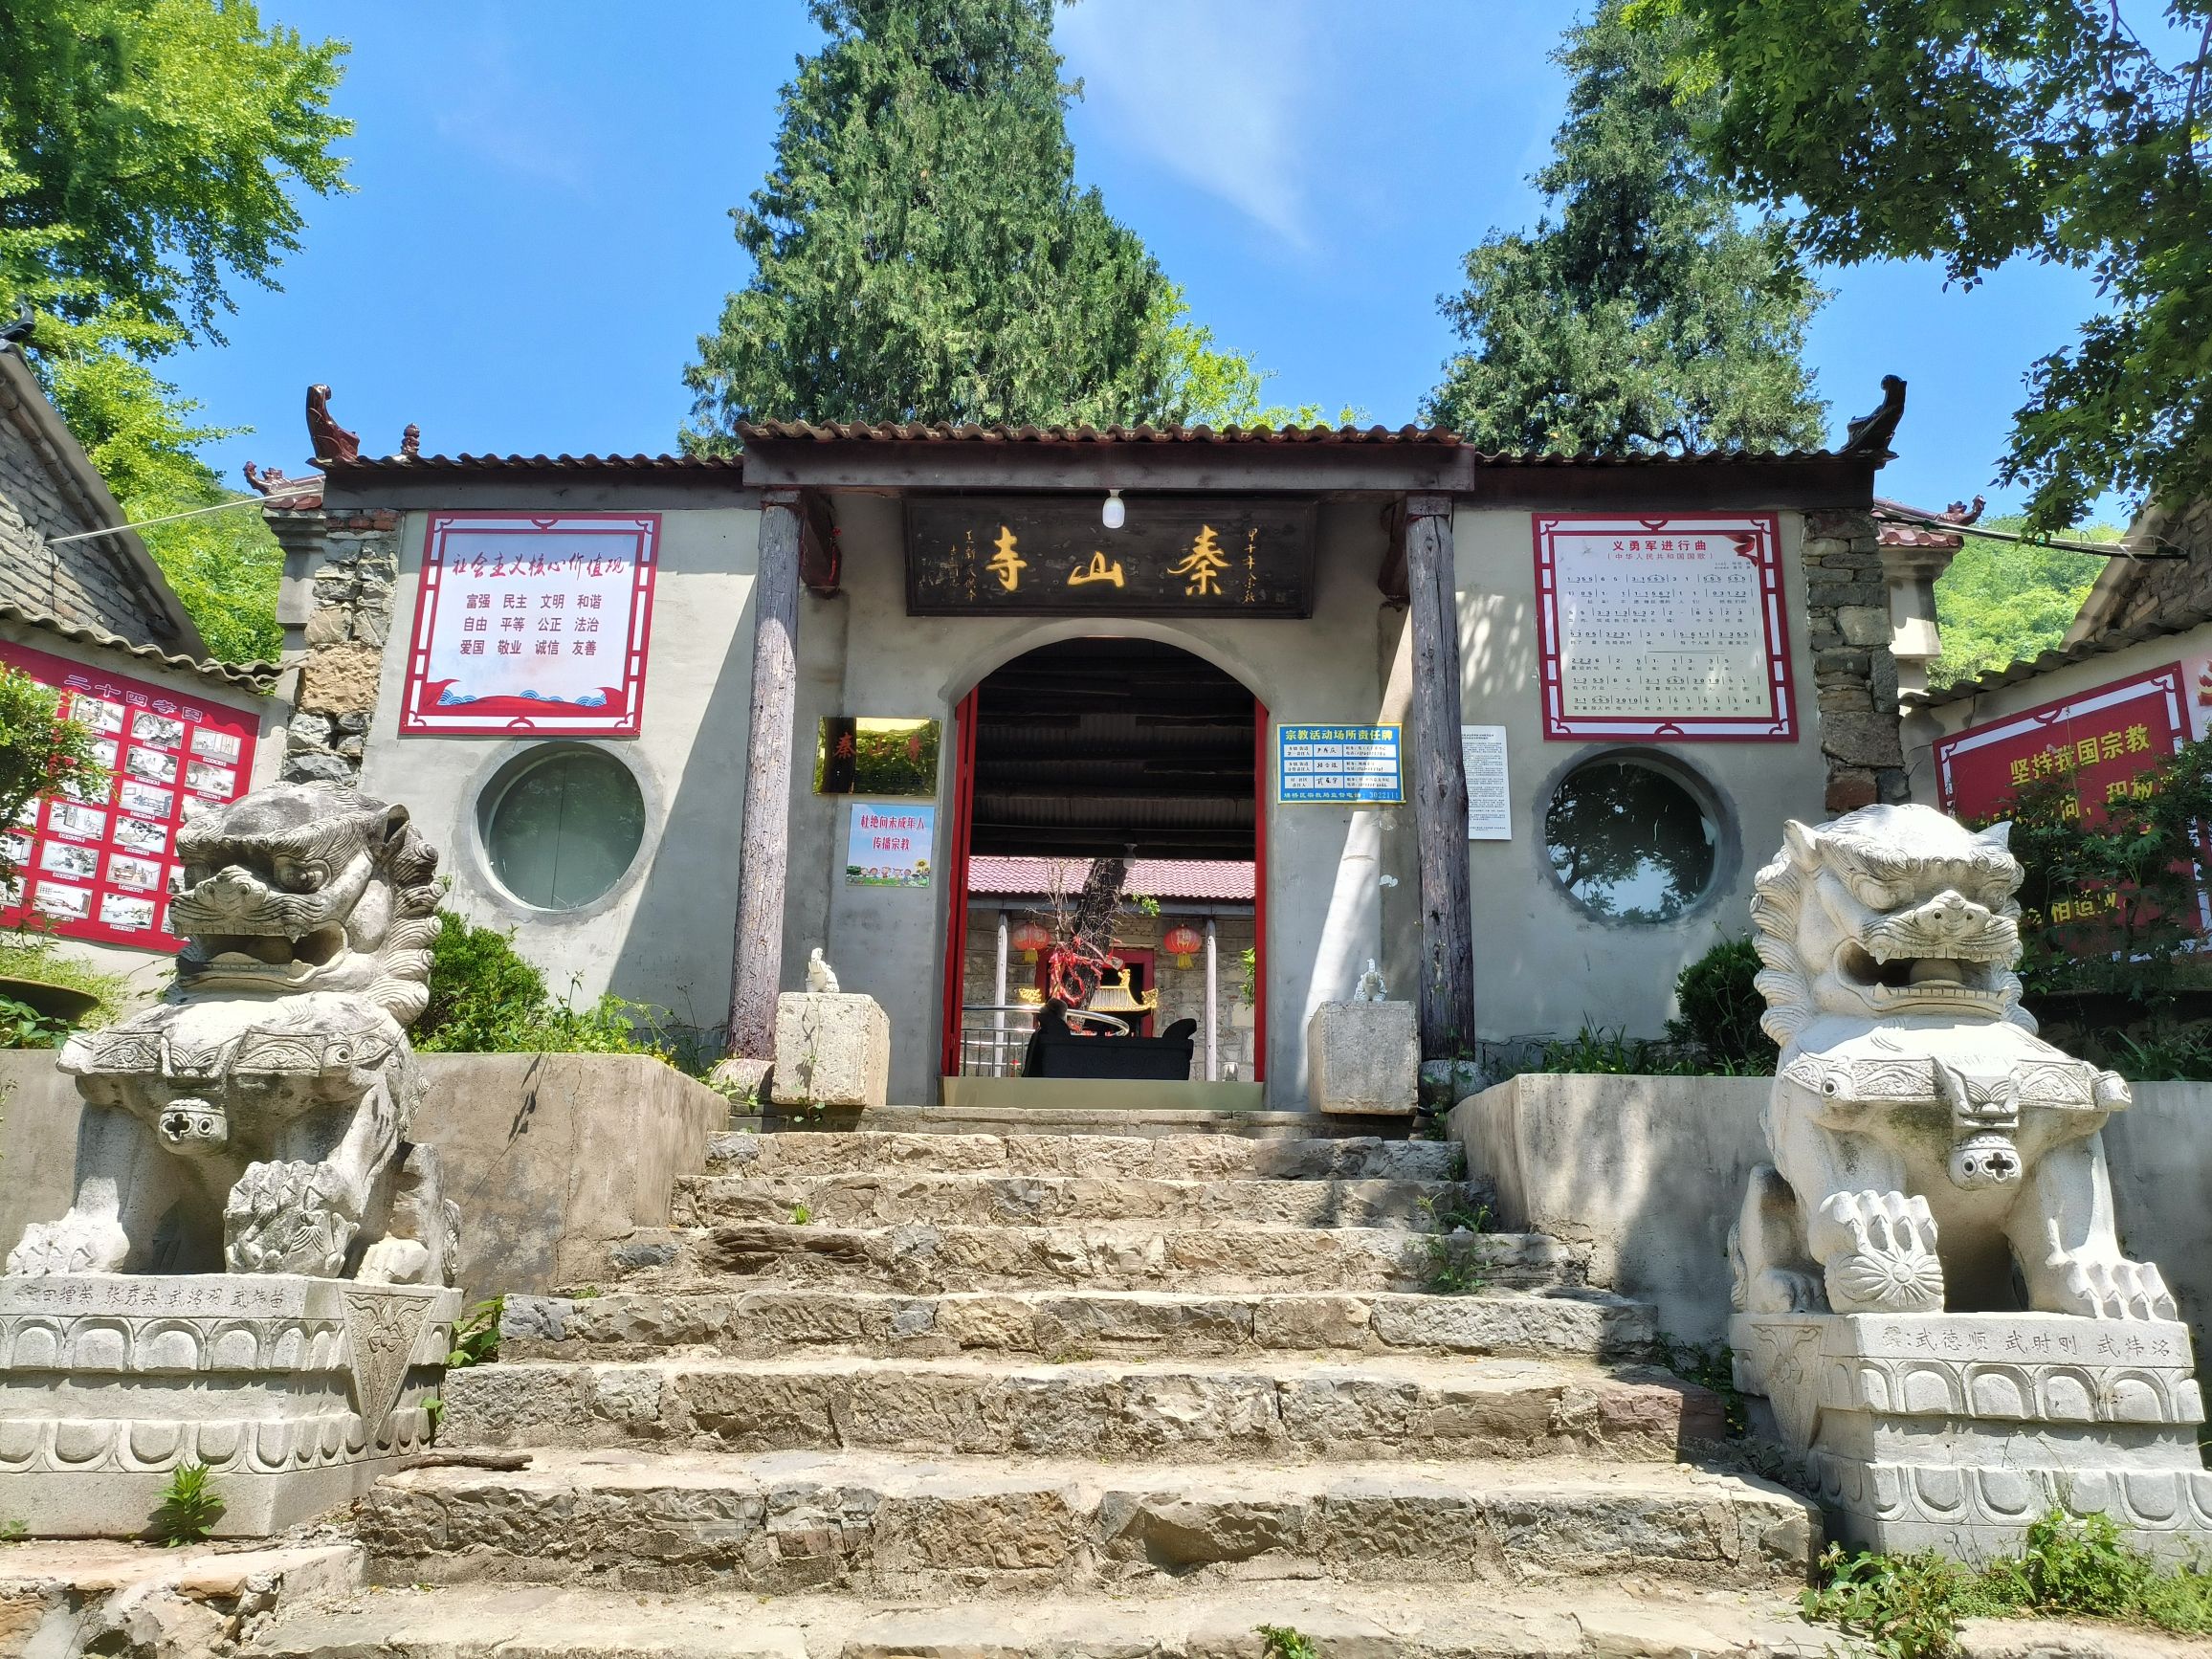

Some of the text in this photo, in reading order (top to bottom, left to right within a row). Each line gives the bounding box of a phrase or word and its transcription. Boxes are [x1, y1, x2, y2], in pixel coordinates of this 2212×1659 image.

[1612, 540, 1707, 552] 义勇军进行曲
[452, 551, 625, 581] 社会主义核心价值观
[466, 593, 603, 609] 富强 民主 文明 和谐
[463, 616, 600, 632] 自由 平等 公正 法治
[459, 639, 597, 655] 爱国 敬业 诚信 友善
[64, 675, 203, 723] 二十四孝图
[1285, 729, 1393, 741] 宗教活动场所责任牌
[2009, 722, 2151, 786] 坚持我国宗教
[860, 814, 926, 831] 杜绝向未成年人
[873, 836, 910, 851] 传播宗教
[104, 1284, 159, 1307] 张秀英
[2004, 1329, 2078, 1356] 武时刚
